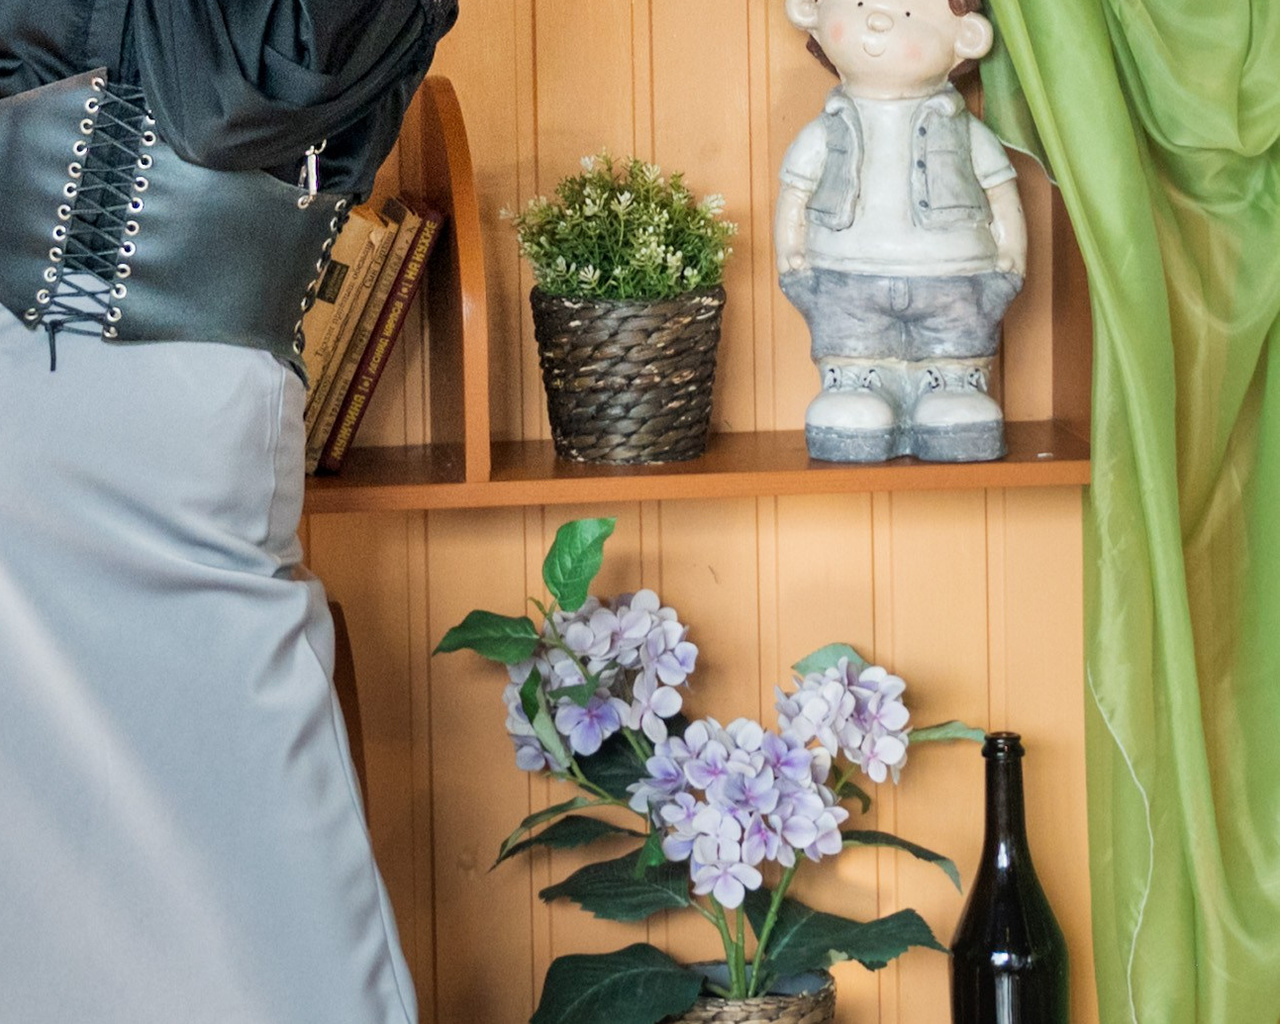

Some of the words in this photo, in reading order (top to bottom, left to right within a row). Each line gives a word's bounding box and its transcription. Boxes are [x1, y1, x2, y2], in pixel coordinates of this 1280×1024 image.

[412, 219, 438, 263] КУХНЕ
[404, 261, 421, 281] НА
[330, 393, 367, 460] МУЖЧИНА
